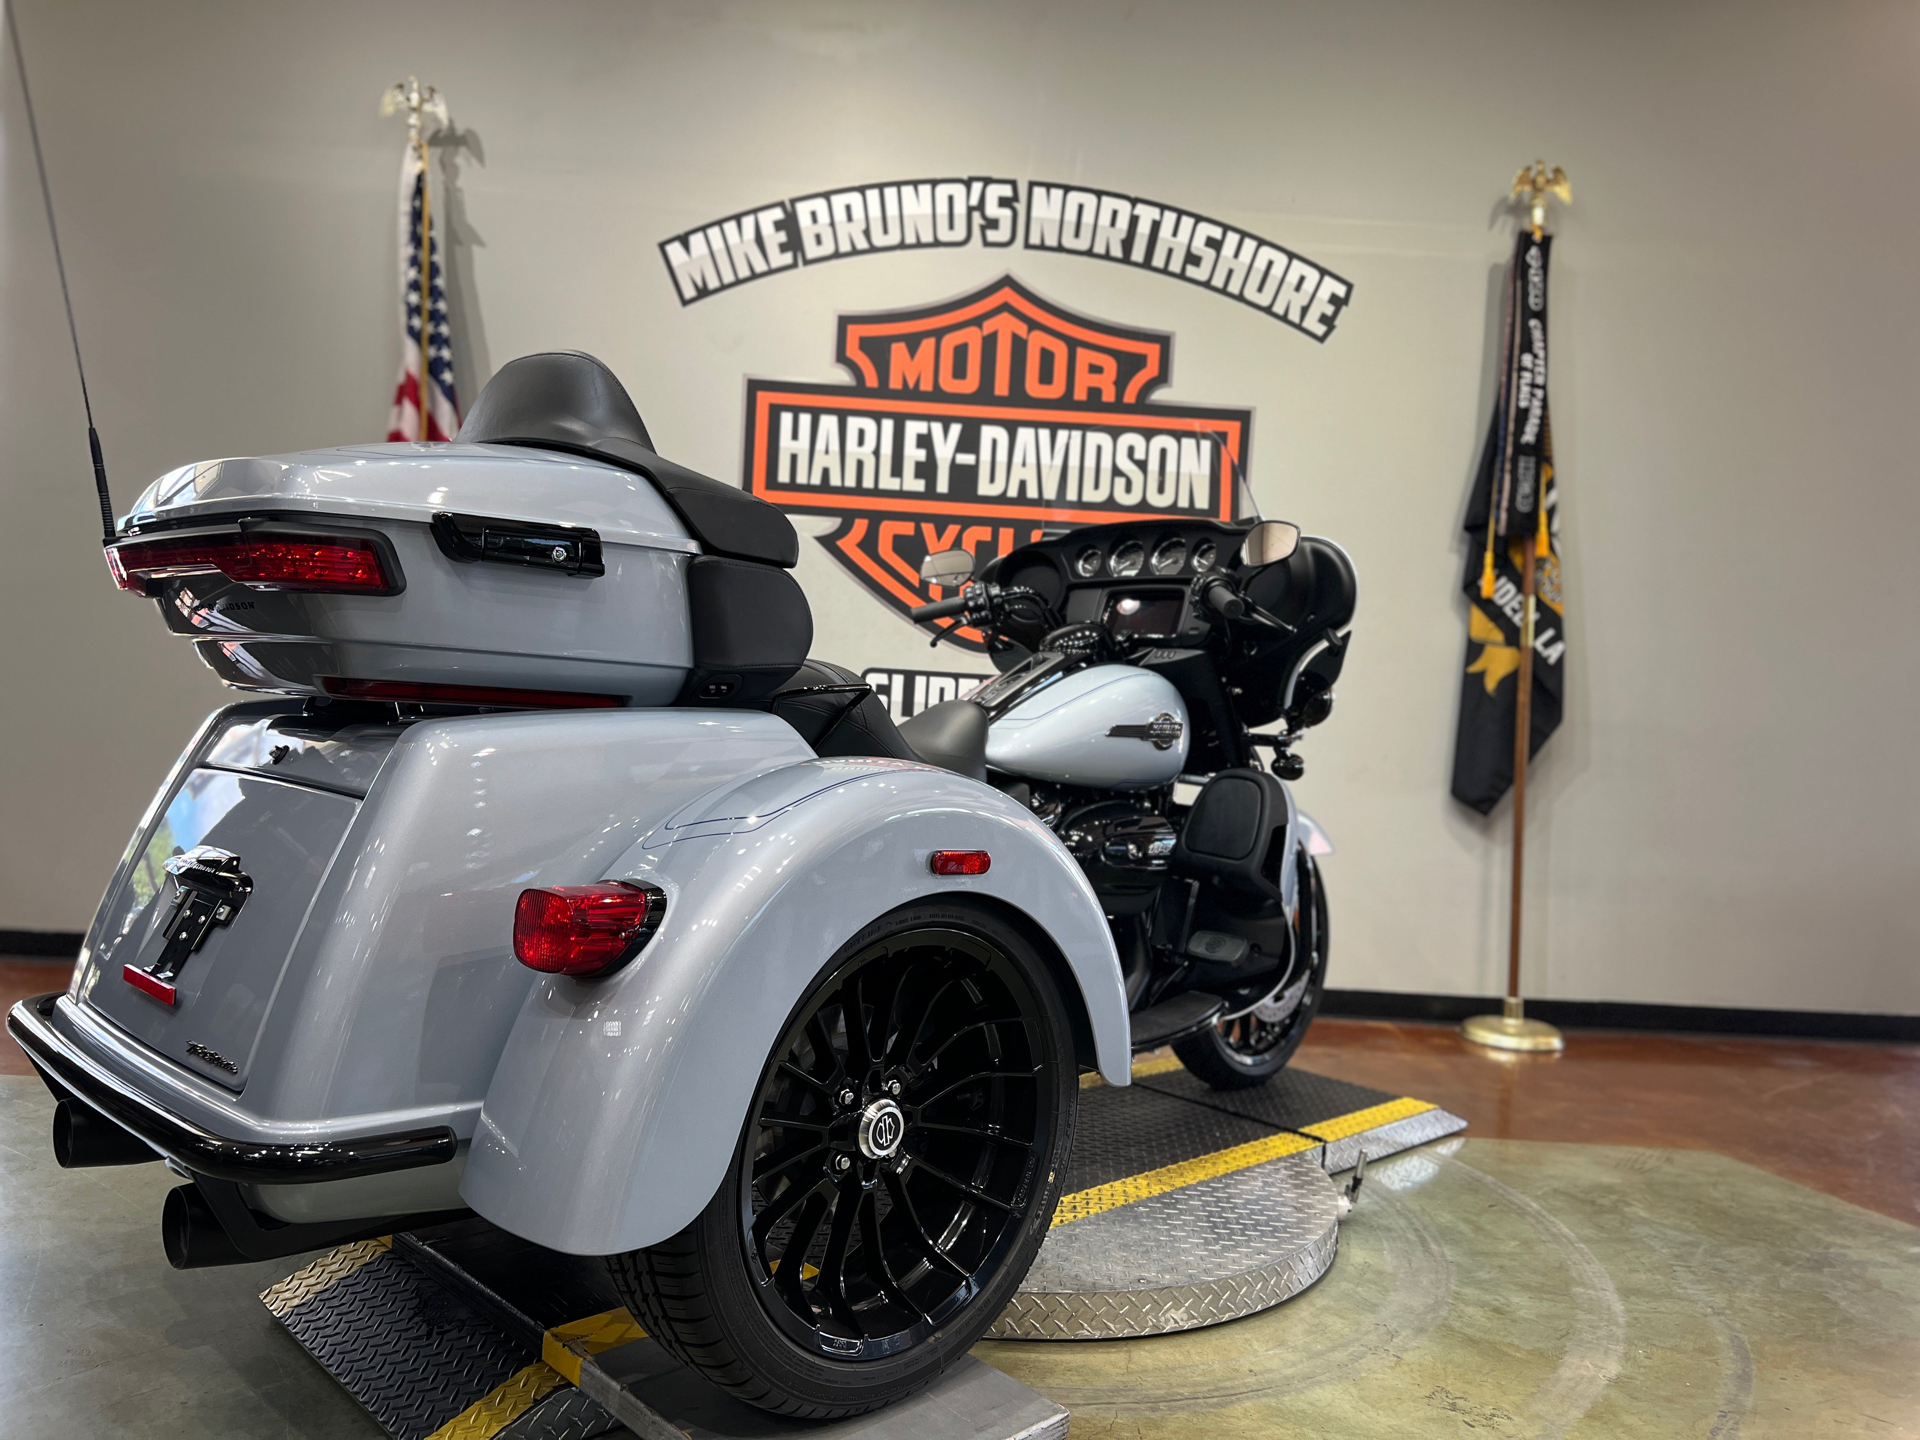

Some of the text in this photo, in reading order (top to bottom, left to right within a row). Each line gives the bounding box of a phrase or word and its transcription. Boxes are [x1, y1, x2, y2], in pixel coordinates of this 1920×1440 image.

[663, 180, 1348, 338] MIKE BRUNO'S NORTHSHORE
[888, 310, 1118, 403] MOTOR
[776, 410, 1212, 511] HARLEY-DAVIDSON
[1534, 627, 1567, 666] LA
